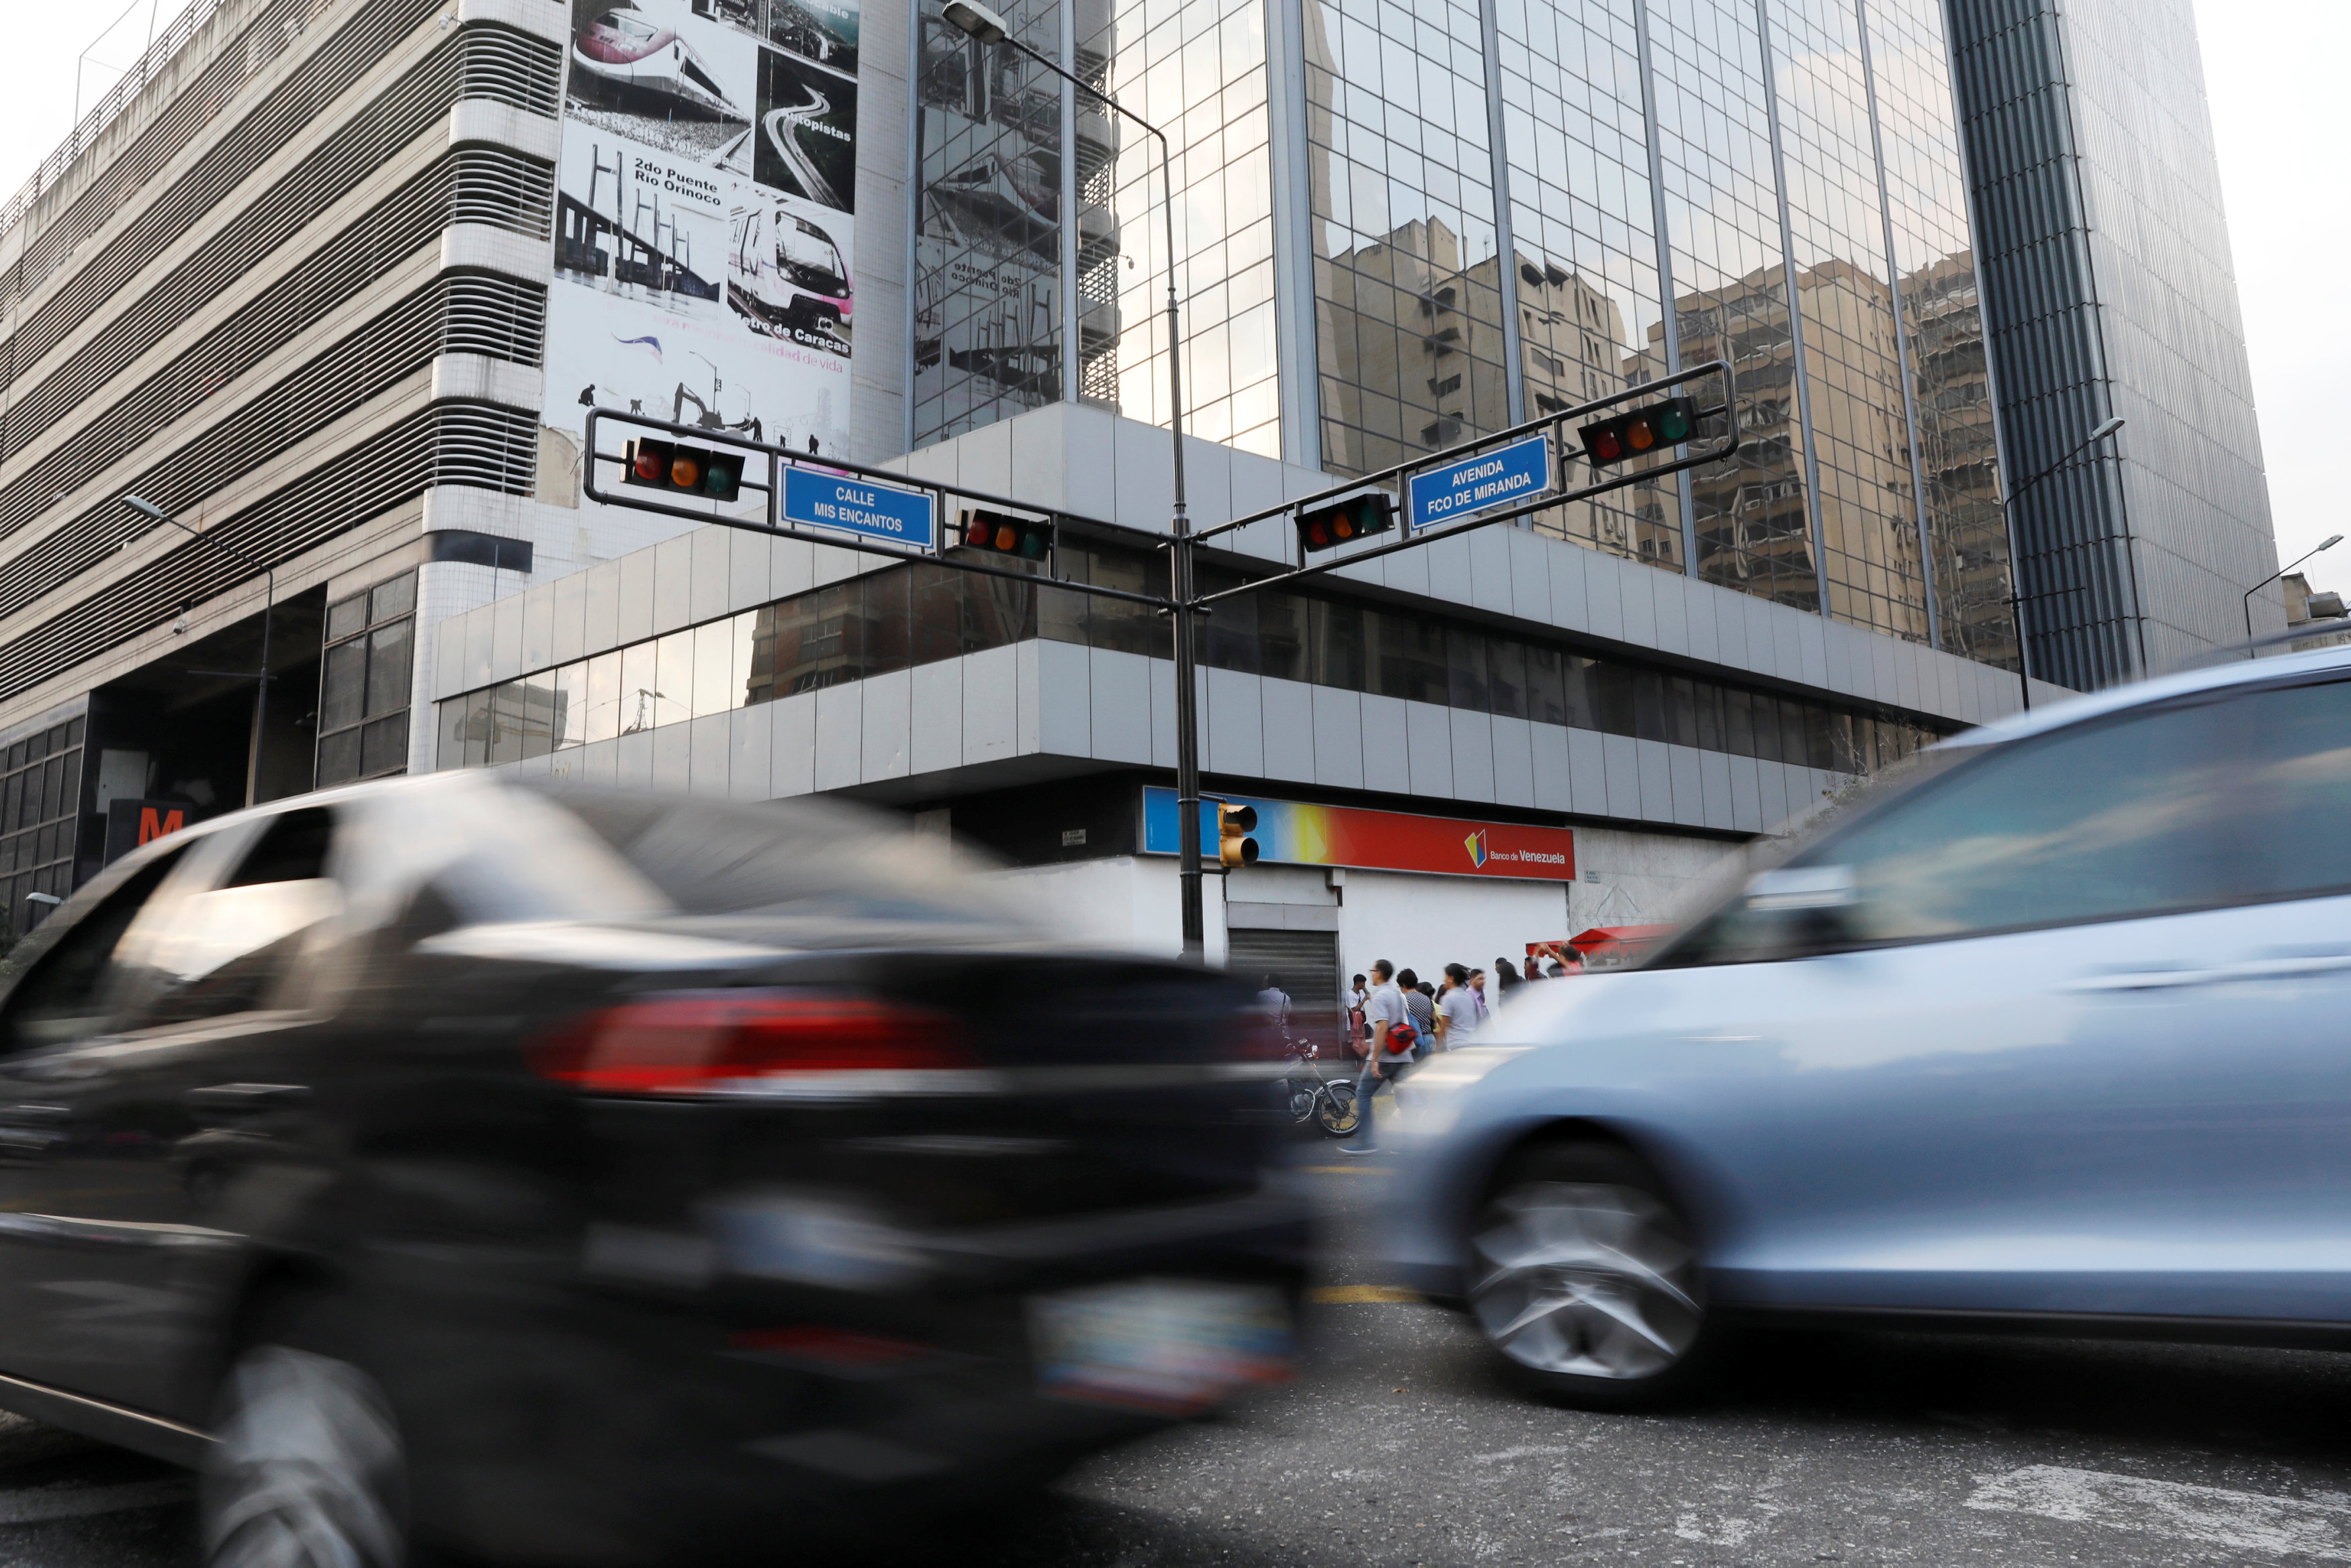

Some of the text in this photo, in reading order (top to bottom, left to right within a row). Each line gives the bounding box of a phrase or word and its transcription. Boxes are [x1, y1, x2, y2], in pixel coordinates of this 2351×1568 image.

[635, 158, 717, 193] 2do Puente
[635, 170, 721, 205] Río Orinoco
[773, 324, 791, 337] de
[795, 328, 850, 354] Caracas
[803, 353, 817, 367] de
[819, 357, 843, 373] vida
[1452, 459, 1504, 488] AVENIDA
[836, 486, 875, 507] CALLE
[1427, 471, 1532, 515] FCO DE MIRANDA
[814, 502, 903, 533] MIS ENCANTOS
[138, 806, 183, 846] M
[1490, 849, 1565, 864] Banco de Venezuela
